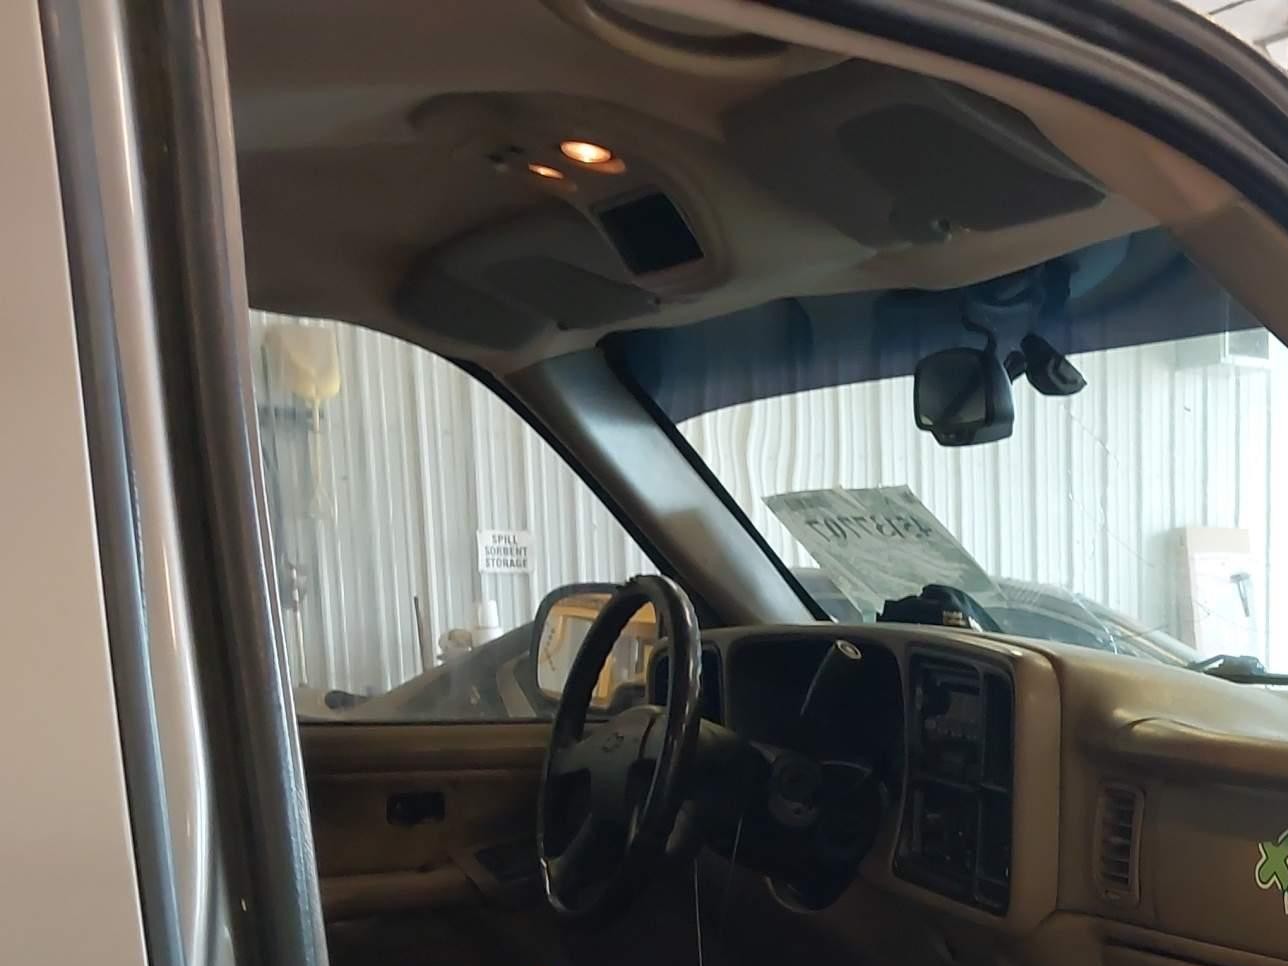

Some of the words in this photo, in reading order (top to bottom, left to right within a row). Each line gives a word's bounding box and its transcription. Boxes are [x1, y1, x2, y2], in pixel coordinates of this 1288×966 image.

[492, 534, 517, 545] SPILL
[485, 546, 528, 557] SORBENT
[486, 558, 528, 568] STORAGE
